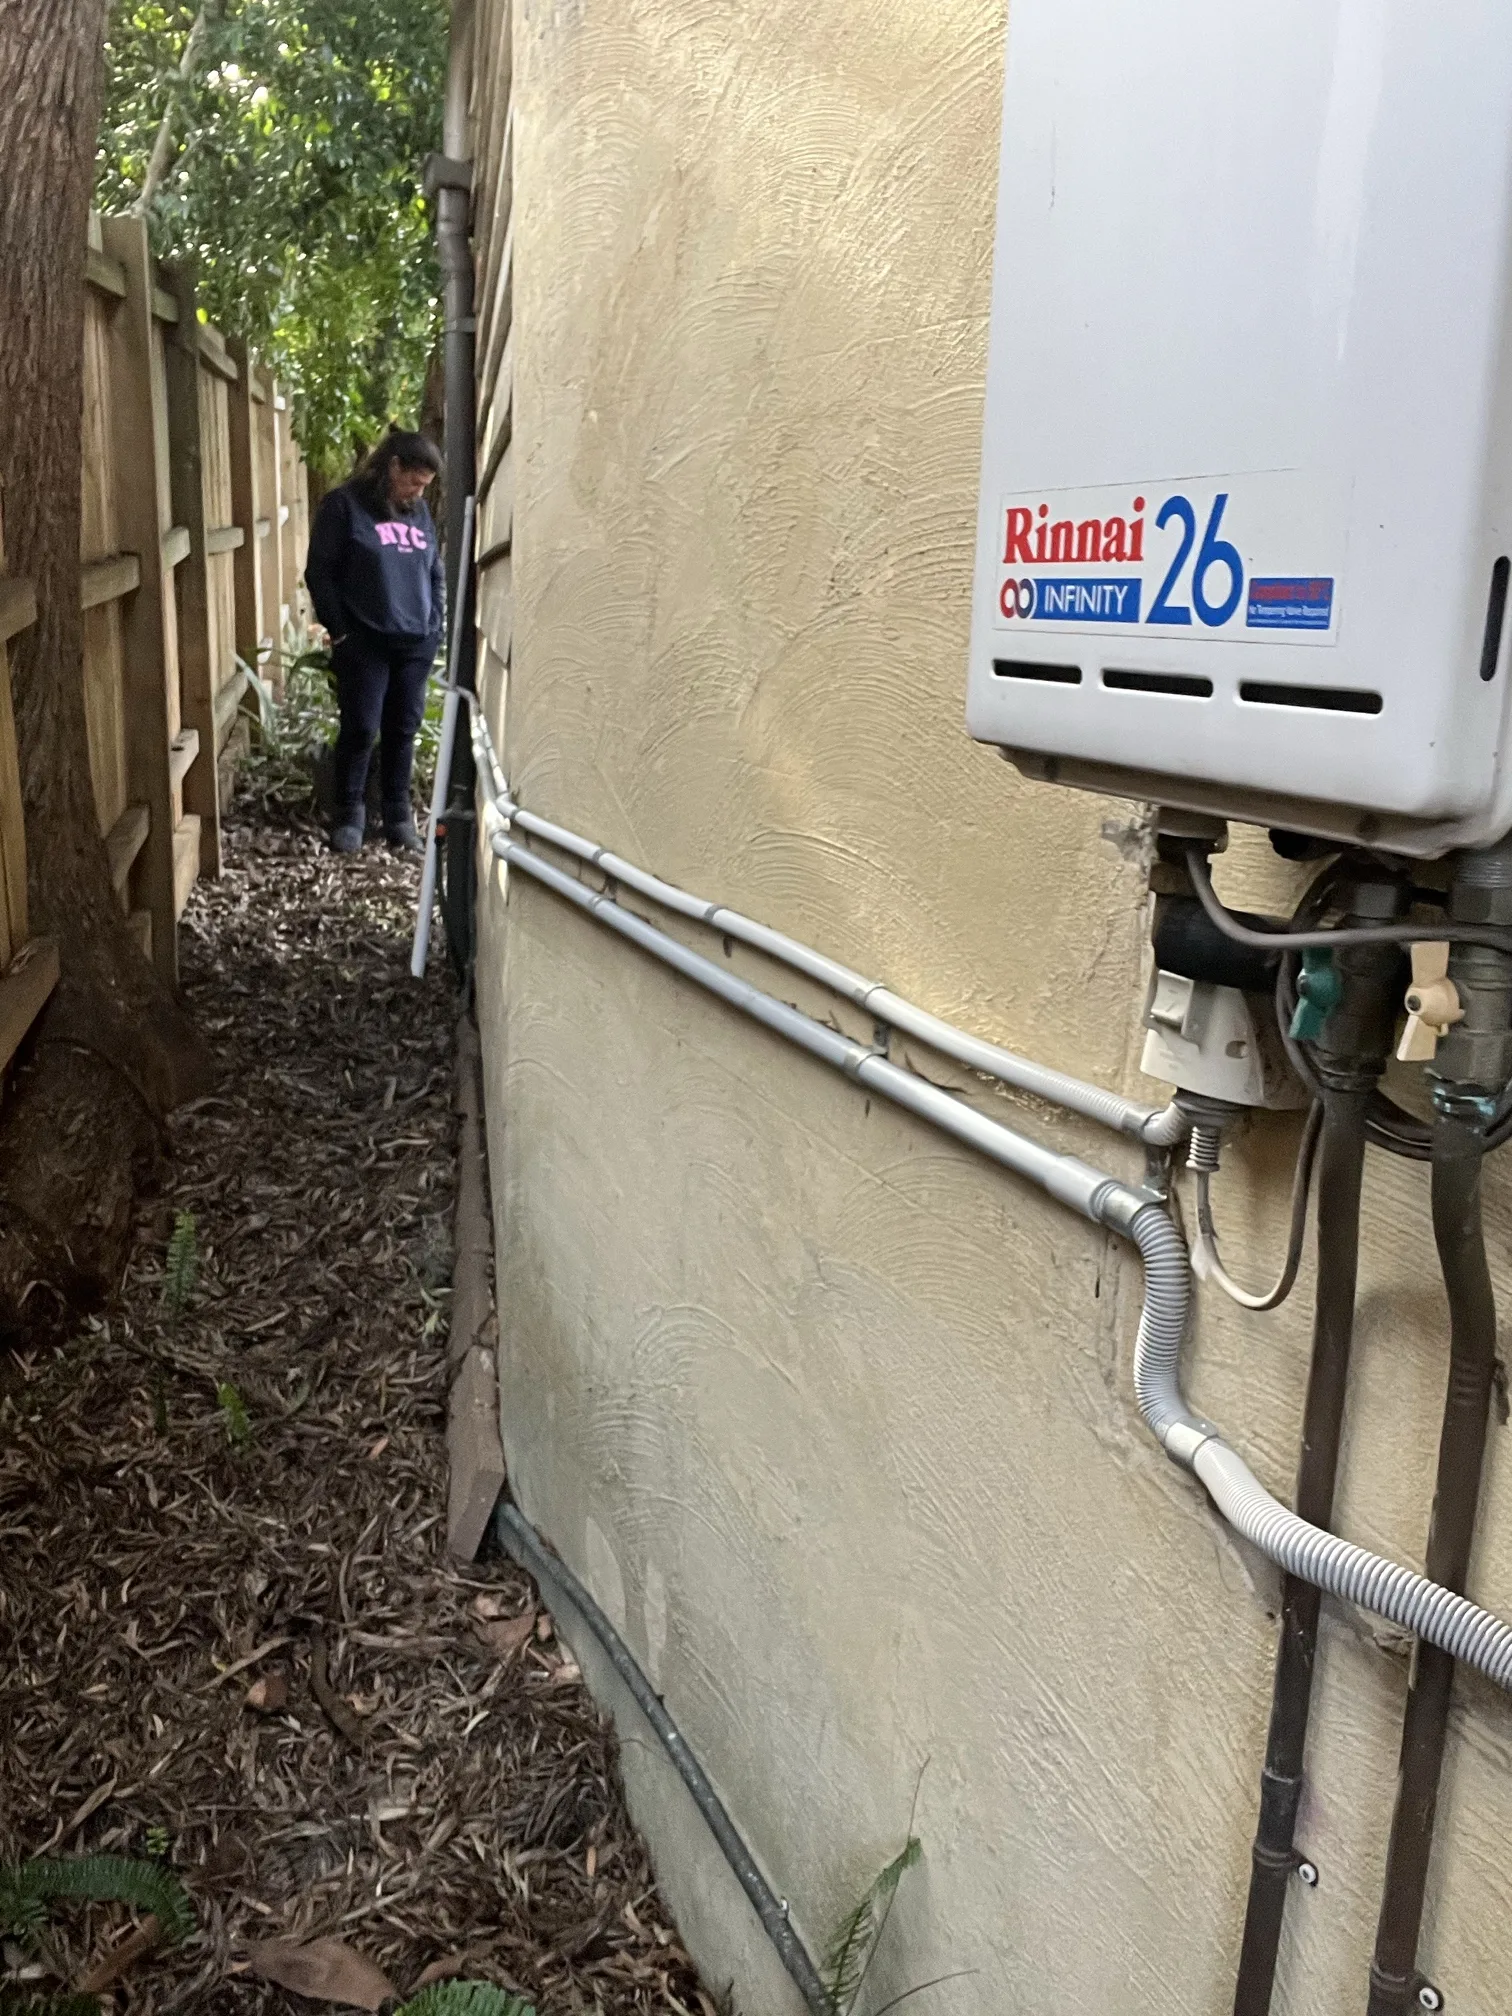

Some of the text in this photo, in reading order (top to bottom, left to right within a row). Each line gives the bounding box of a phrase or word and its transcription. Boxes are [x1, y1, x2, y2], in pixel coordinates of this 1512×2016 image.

[375, 522, 427, 550] NYC
[1002, 496, 1145, 563] Rinnai
[1145, 493, 1243, 627] 26
[1044, 585, 1128, 615] INFINITY
